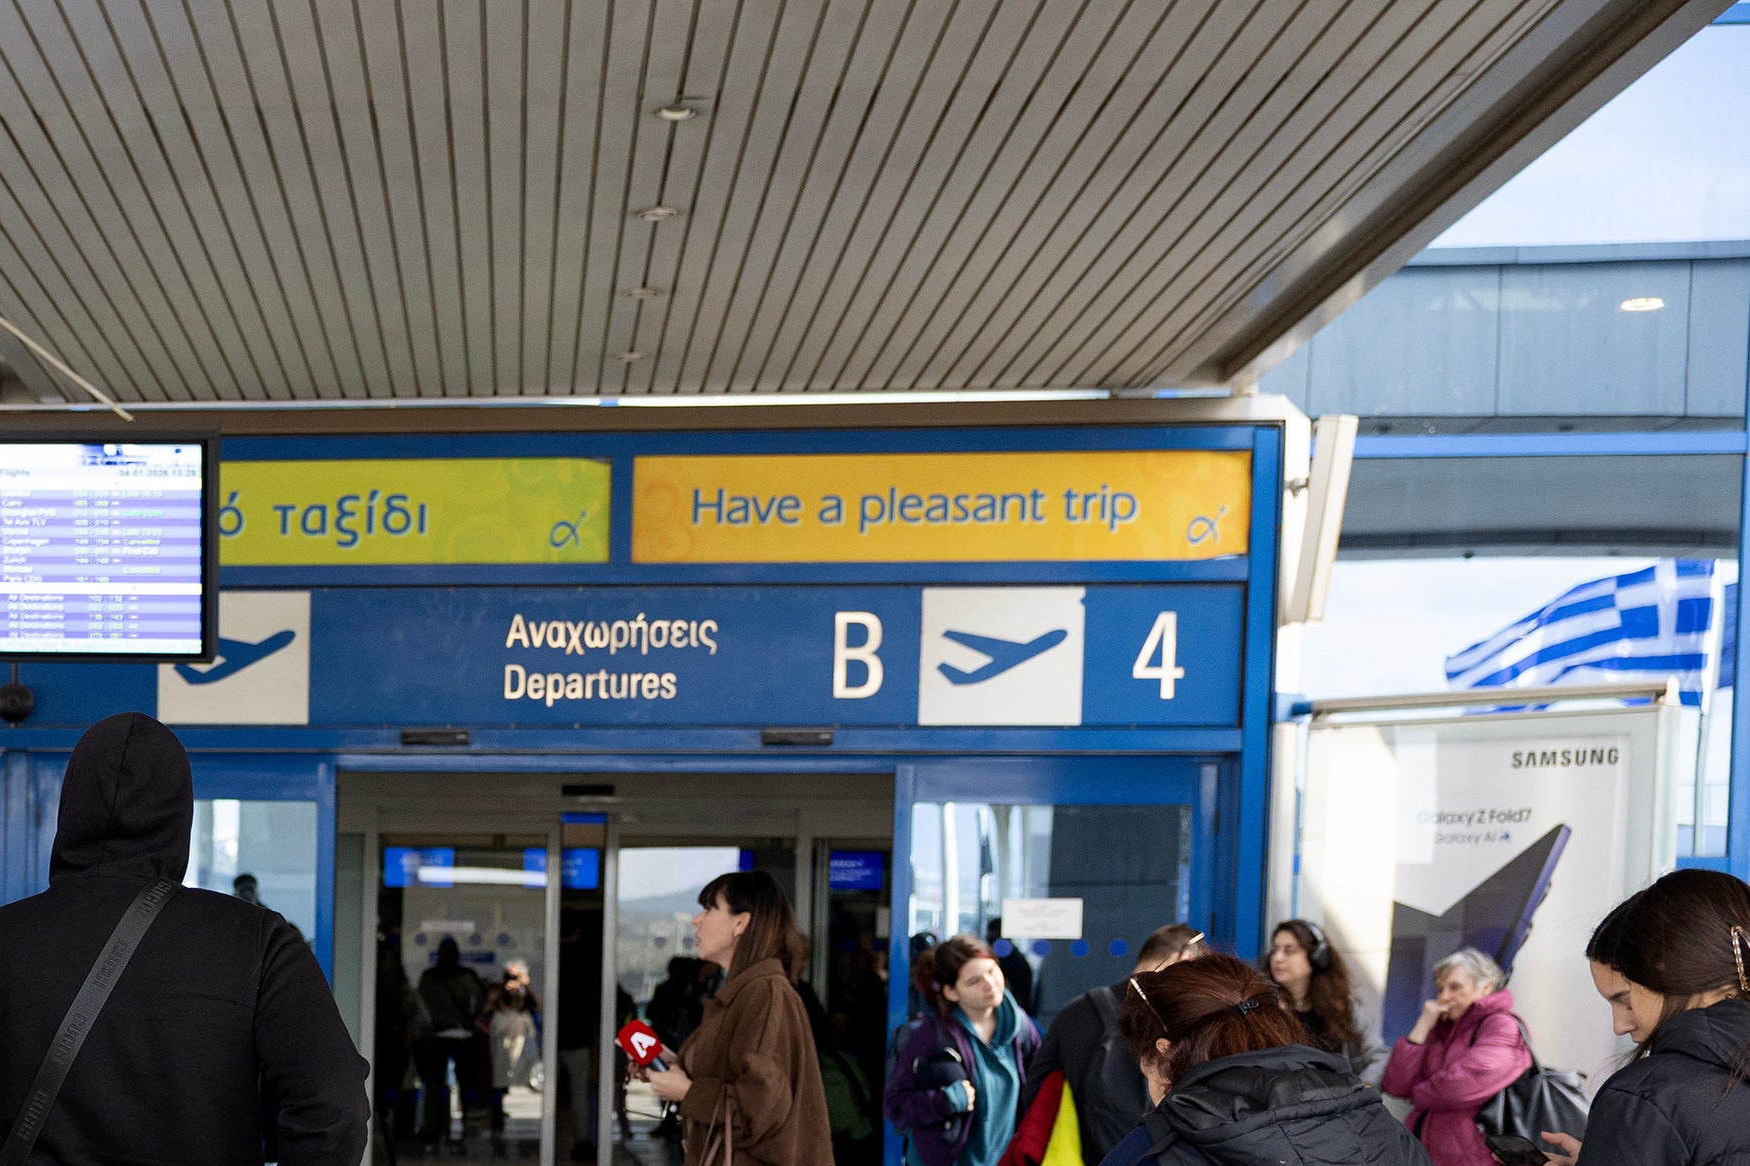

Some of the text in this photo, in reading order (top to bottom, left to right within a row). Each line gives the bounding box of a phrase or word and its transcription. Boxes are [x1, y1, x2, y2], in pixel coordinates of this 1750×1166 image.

[0, 468, 30, 478] Flights
[273, 490, 428, 548] ταξίδι
[692, 483, 1139, 534] Have a pleasant trip
[505, 612, 719, 655] Αναχωρήσεις
[833, 611, 884, 699] B
[1132, 611, 1185, 700] 4
[503, 664, 678, 707] Departures
[1511, 748, 1619, 769] SAMSUNG
[1477, 810, 1486, 824] Z
[1488, 808, 1532, 824] Fold7
[1435, 832, 1481, 845] Galaxy
